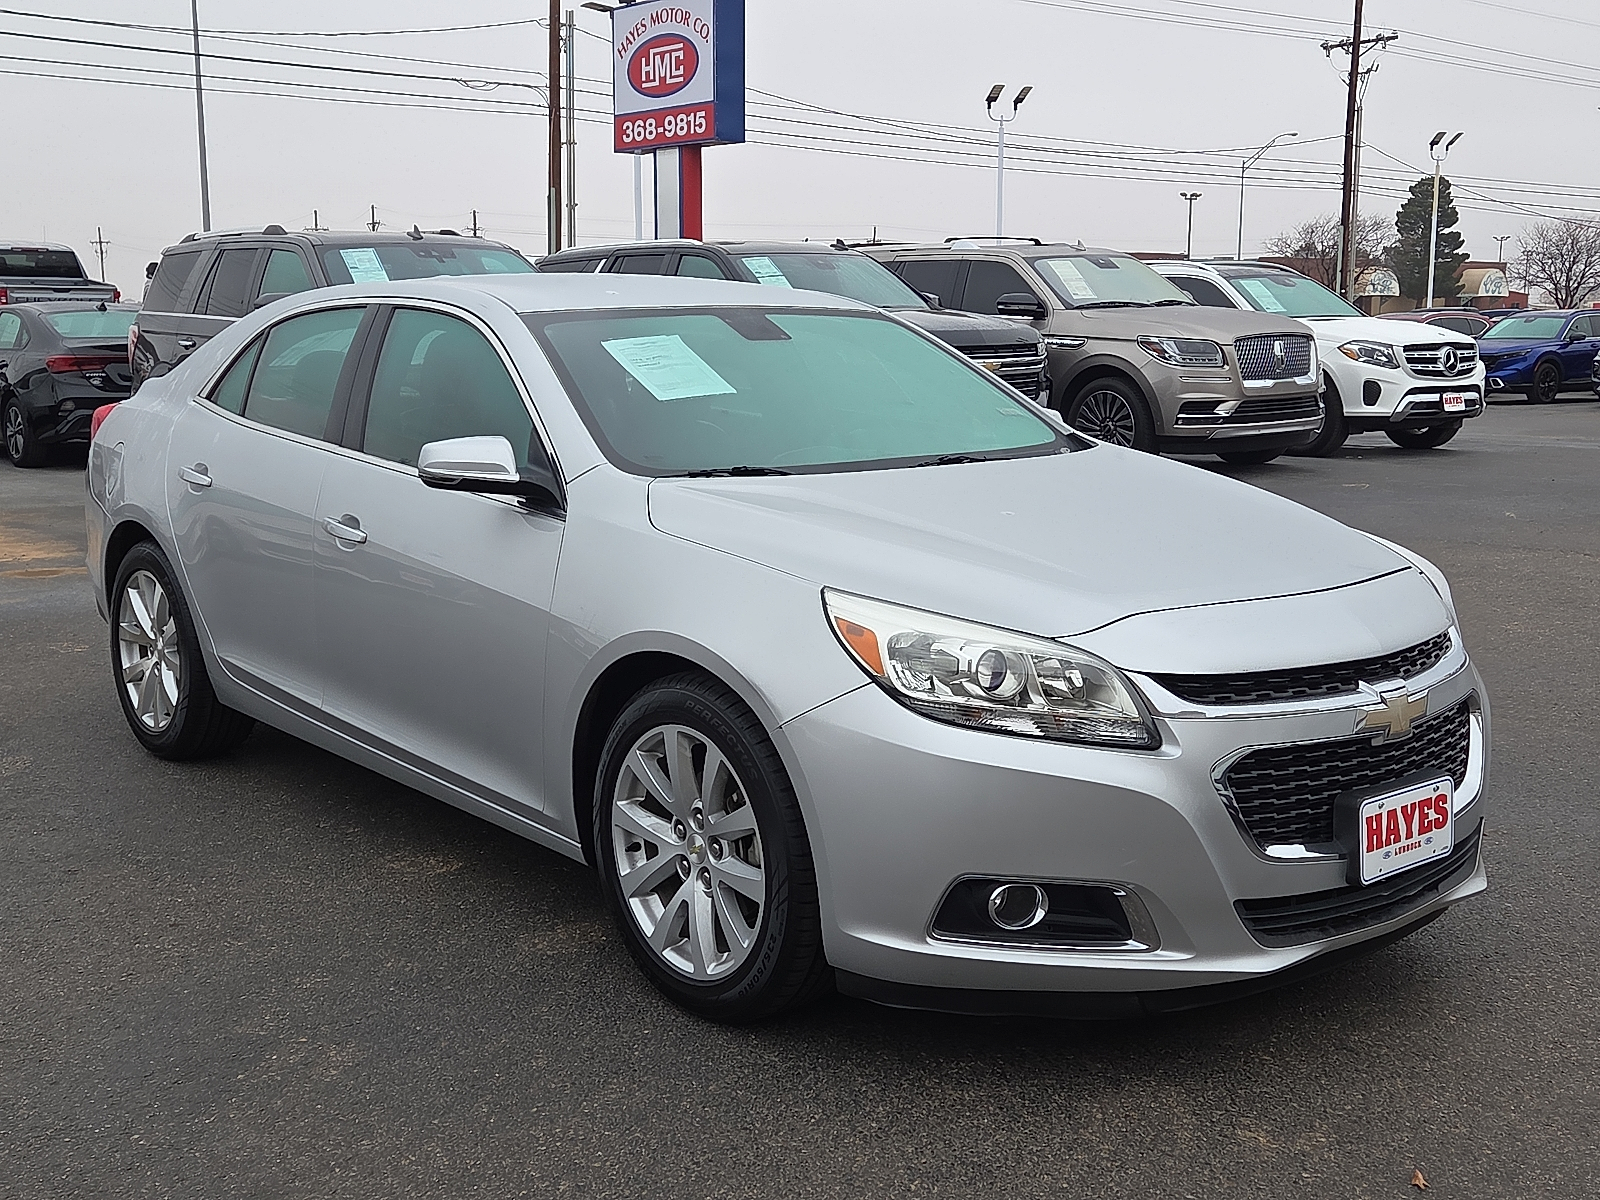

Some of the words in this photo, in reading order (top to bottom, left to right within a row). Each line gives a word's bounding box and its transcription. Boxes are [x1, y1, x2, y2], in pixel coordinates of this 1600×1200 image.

[617, 17, 648, 60] HAYES
[649, 7, 691, 28] MOTOR
[693, 17, 710, 43] CO.
[641, 42, 684, 88] HMC
[622, 110, 707, 143] 368-9815
[1444, 396, 1463, 405] HAYES
[683, 699, 759, 780] PERFECTUS
[1365, 793, 1449, 854] HAYES
